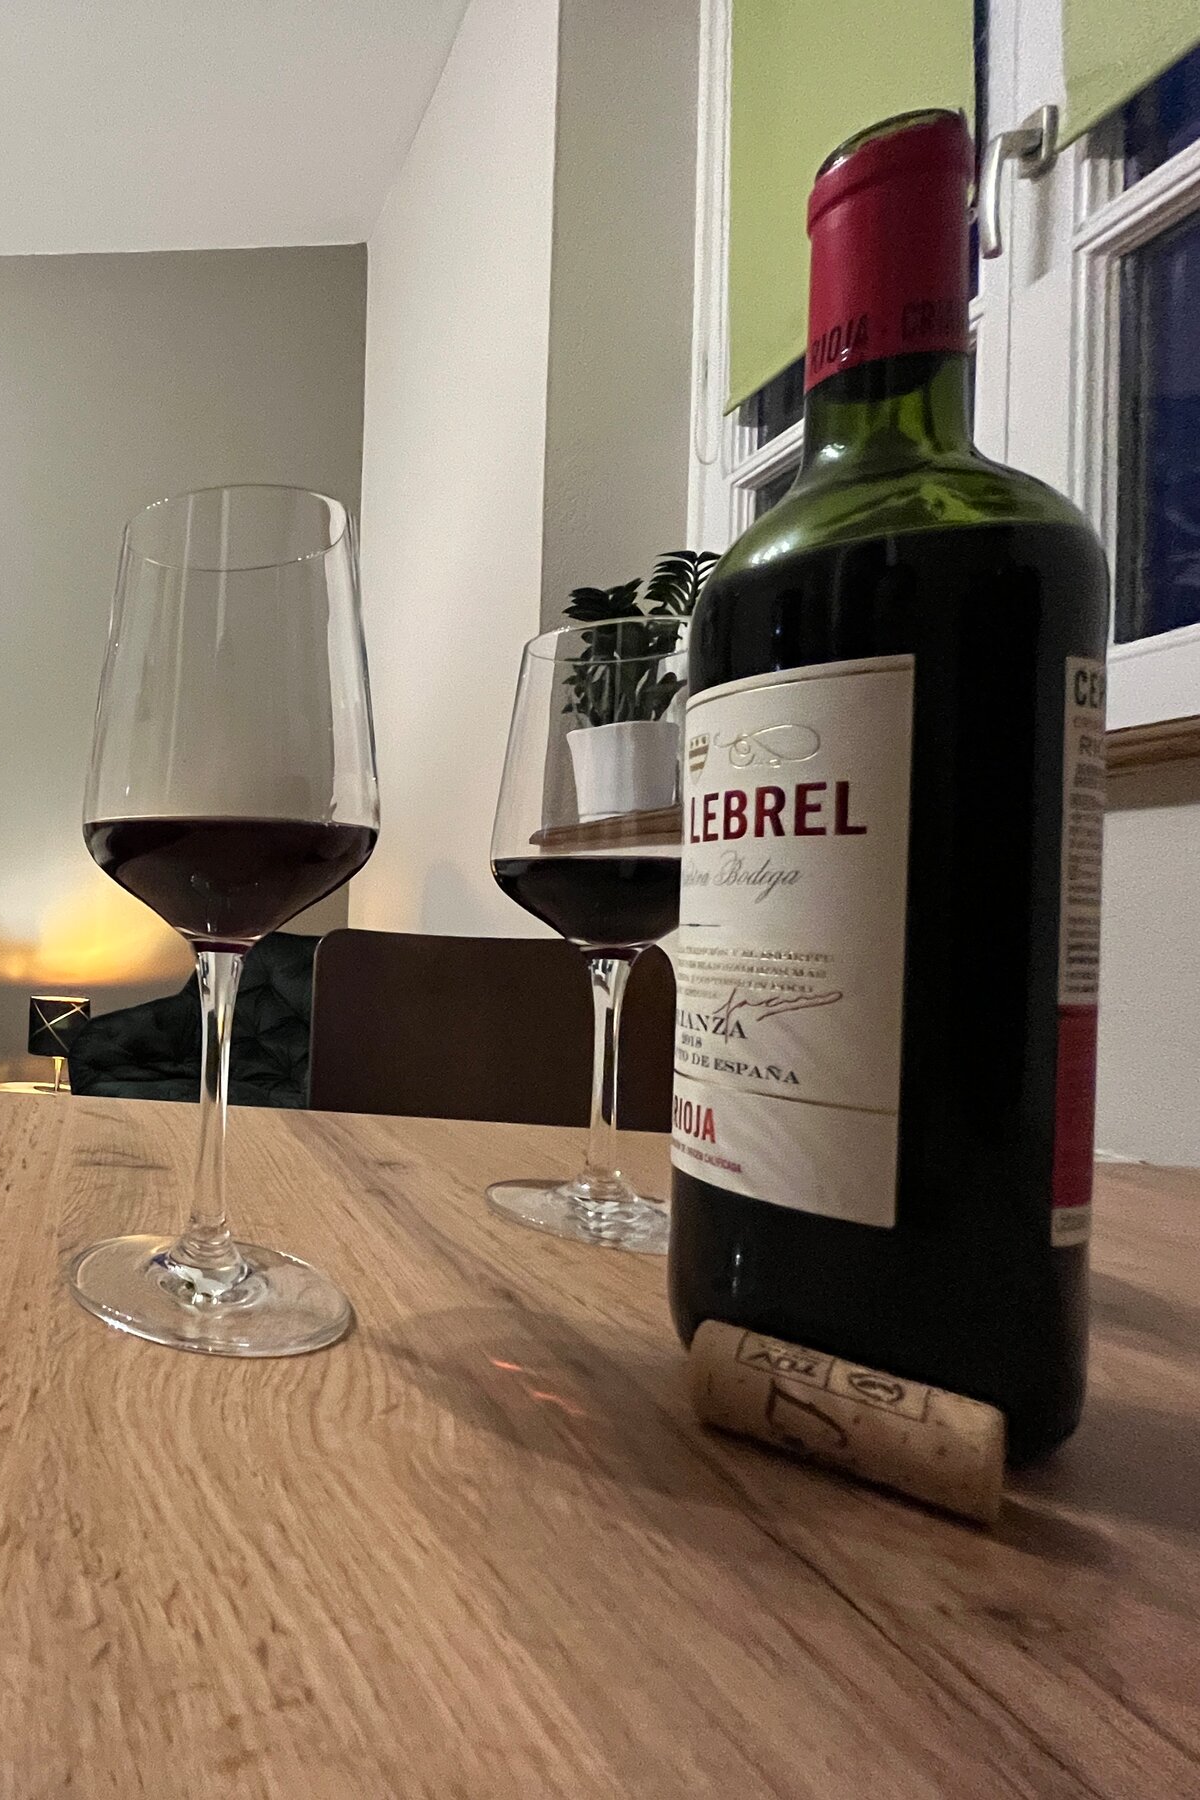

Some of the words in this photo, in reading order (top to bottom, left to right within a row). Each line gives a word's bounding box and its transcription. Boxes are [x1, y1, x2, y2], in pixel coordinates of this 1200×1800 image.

[689, 780, 868, 844] LEBREL
[713, 850, 801, 904] Bodega
[691, 1053, 710, 1069] DE
[713, 1057, 800, 1085] ESPAÑA
